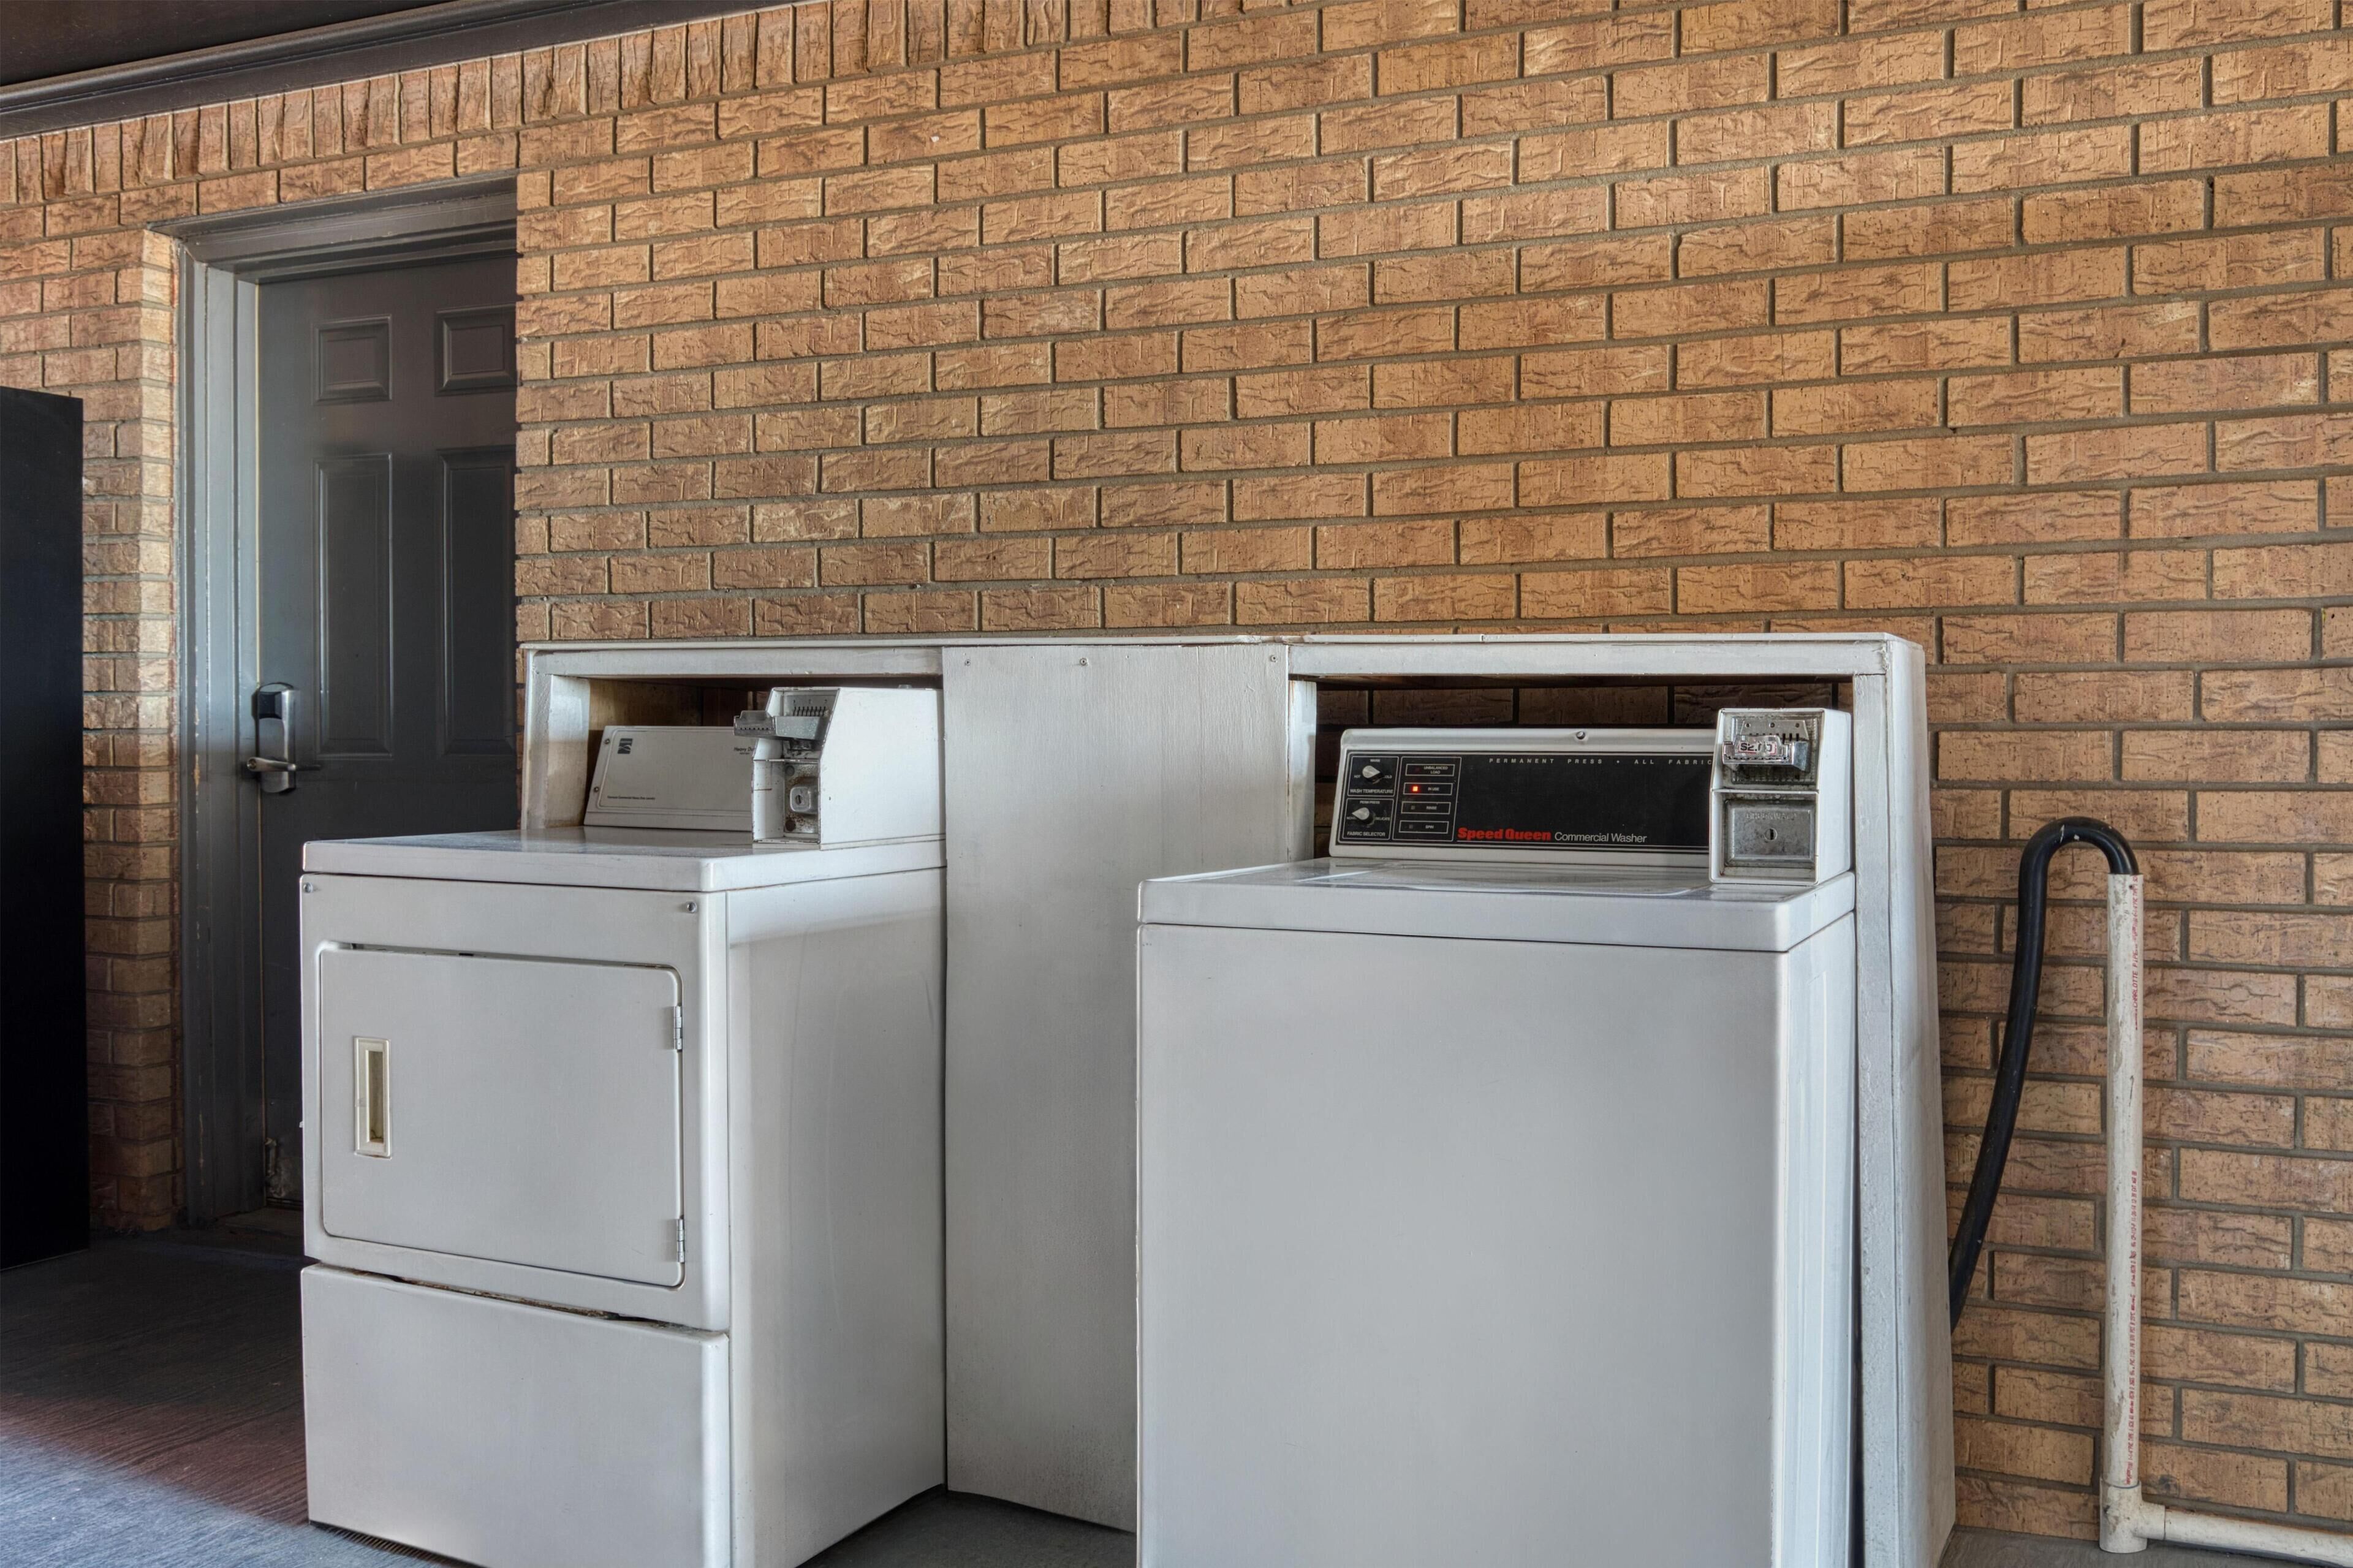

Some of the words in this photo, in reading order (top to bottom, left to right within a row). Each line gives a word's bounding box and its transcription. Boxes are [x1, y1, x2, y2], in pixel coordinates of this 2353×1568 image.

[1458, 827, 1504, 840] Speed
[1505, 828, 1551, 840] Queen
[1555, 831, 1609, 842] Commercial
[1611, 833, 1647, 843] Washer
